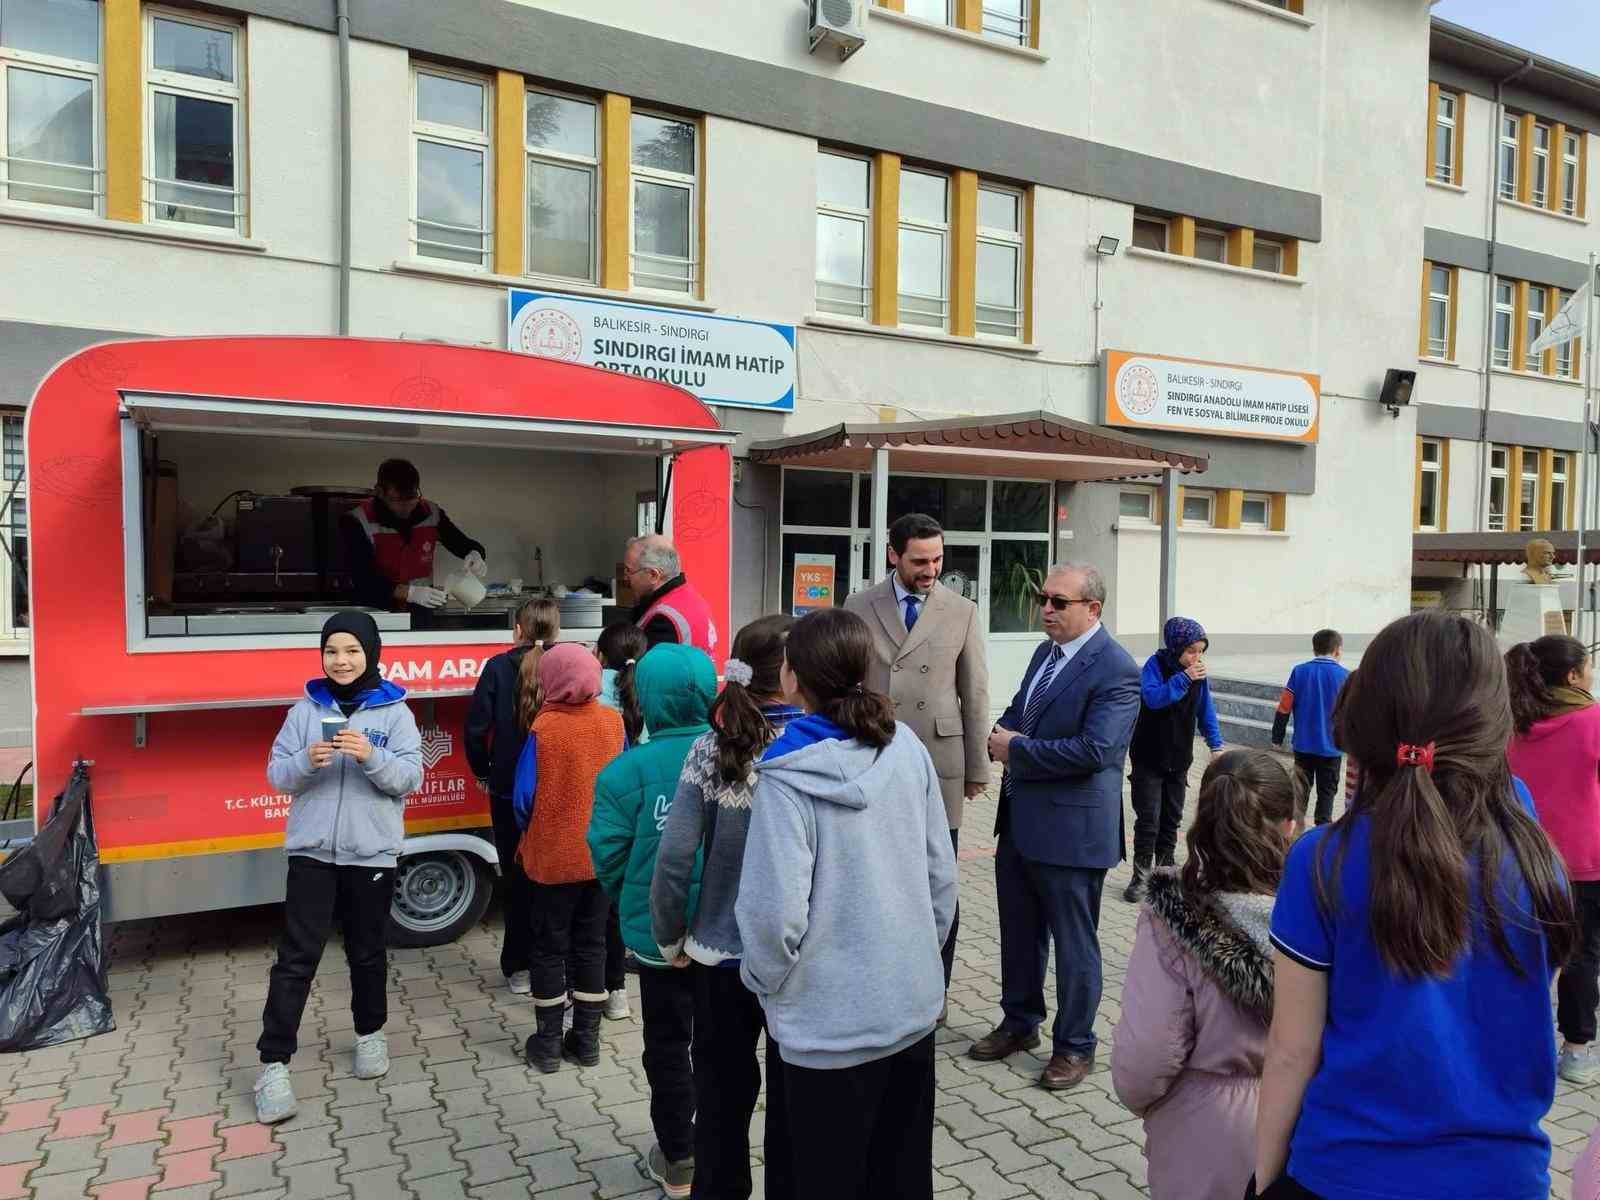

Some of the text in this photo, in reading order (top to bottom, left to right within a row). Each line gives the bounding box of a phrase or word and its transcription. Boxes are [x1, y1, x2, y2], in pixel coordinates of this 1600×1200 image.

[660, 324, 709, 341] SINDIRGI
[593, 338, 785, 375] SINDIRGI İMAM HATİP
[1167, 391, 1309, 414] SINDIRGI ANADOLU İMAM HATİP LİSESİ
[1167, 405, 1309, 427] FEN VE SOSYAL BİLİMLER PROJE OKULU
[800, 572, 821, 582] YKS
[224, 798, 249, 811] T.C.
